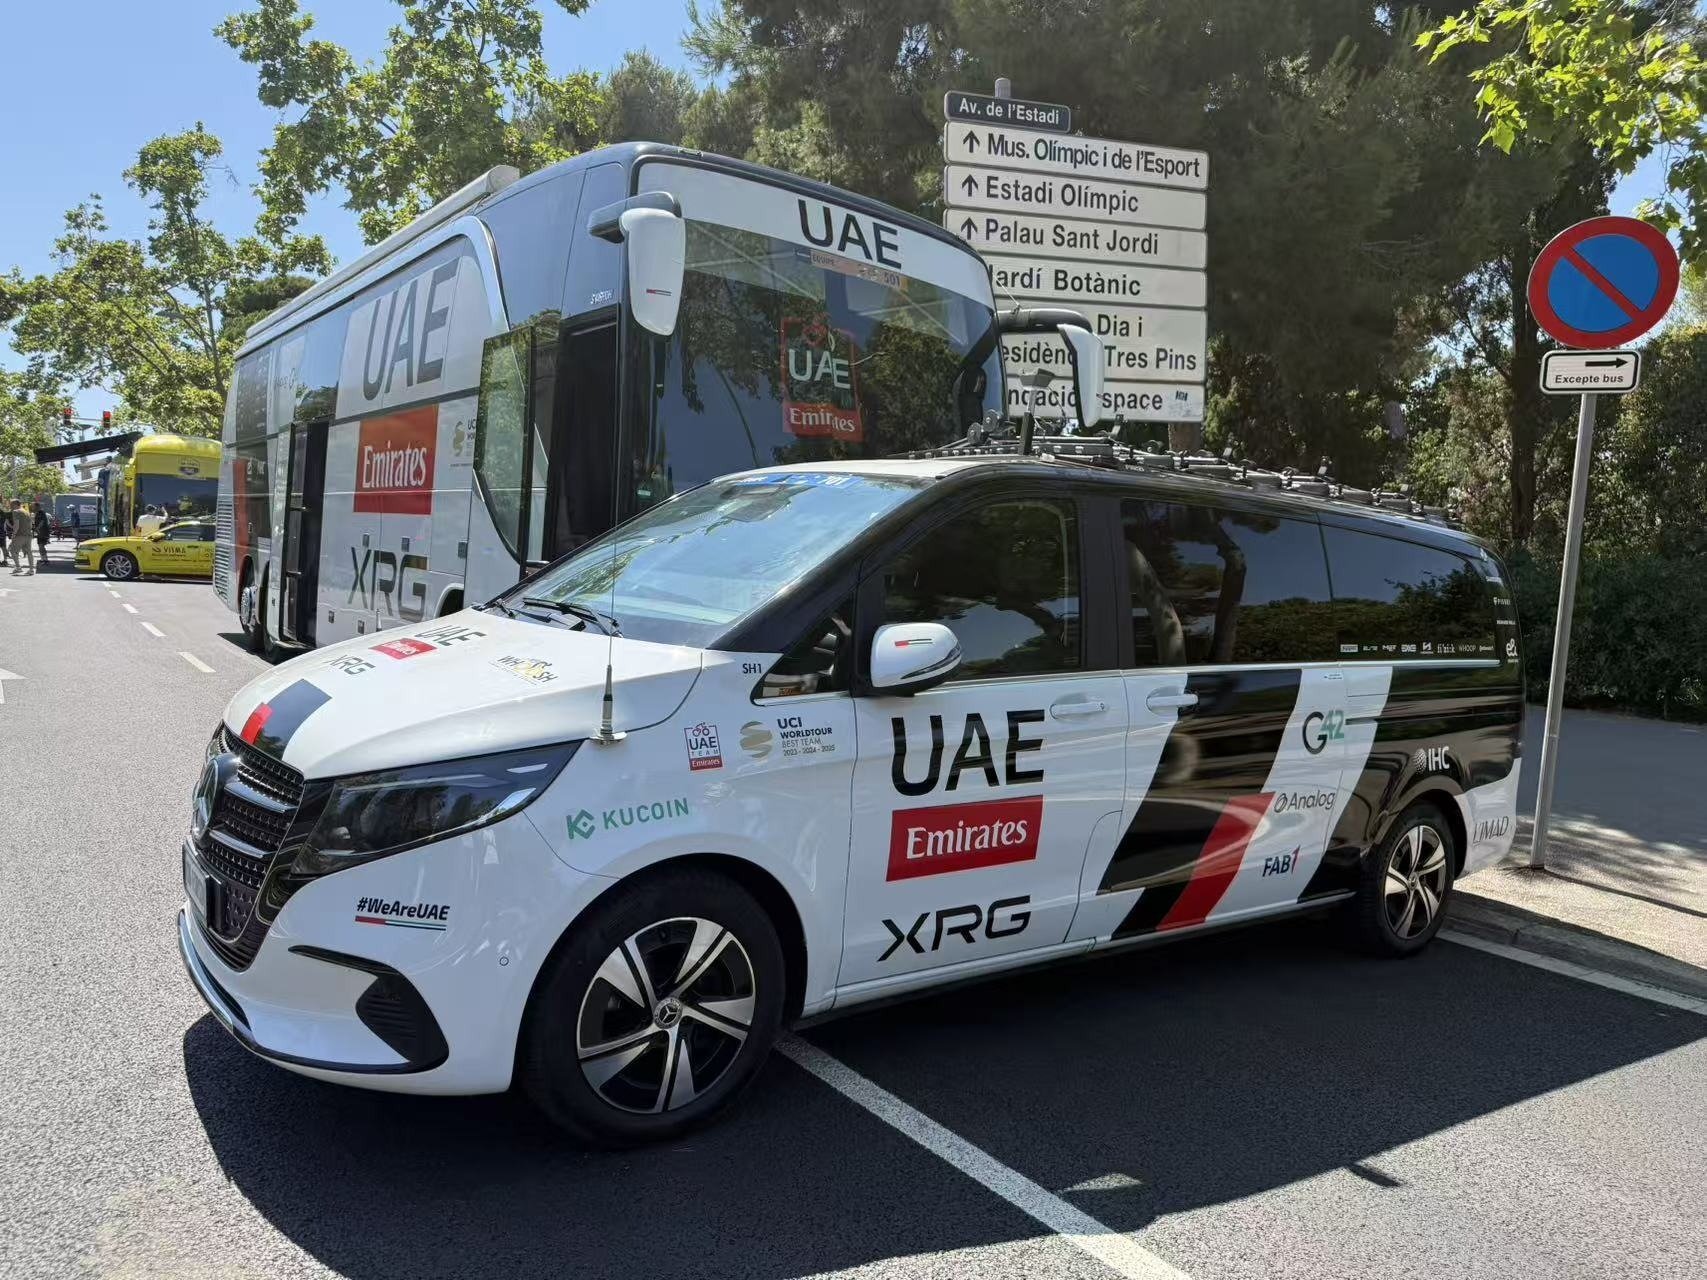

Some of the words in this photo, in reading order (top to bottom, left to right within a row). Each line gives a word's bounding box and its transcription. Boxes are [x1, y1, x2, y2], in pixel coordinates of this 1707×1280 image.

[959, 98, 981, 115] Av.
[986, 101, 1003, 117] de
[1008, 102, 1059, 125] l'Estadi
[987, 133, 1030, 159] Mus.
[1034, 138, 1099, 169] Olímpic
[1102, 147, 1108, 167] i
[1111, 148, 1132, 171] de
[1136, 150, 1200, 179] l'Esport
[986, 176, 1053, 204] Estadi
[1061, 184, 1139, 215] Olímpic
[798, 199, 902, 269] UAE
[985, 218, 1044, 245] Palau
[1053, 224, 1099, 250] Sant
[1106, 230, 1158, 255] Jordi
[1054, 268, 1141, 296] Botànic
[363, 256, 462, 400] UAE
[1097, 313, 1130, 337] Dia
[1137, 316, 1143, 337] i
[788, 349, 851, 389] UAE
[1104, 345, 1148, 368] Tres
[1155, 348, 1197, 370] Pins
[1555, 374, 1600, 385] Excepte
[1602, 374, 1624, 383] bus
[361, 436, 426, 489] Emirates
[350, 547, 428, 616] XRG
[742, 663, 762, 674] SH1
[777, 716, 803, 729] UCI
[780, 727, 833, 739] WORLDTOUR
[1302, 709, 1345, 755] G42
[689, 736, 718, 750] UAE
[782, 740, 800, 748] BEST
[801, 738, 822, 746] TEAM
[891, 709, 1045, 796] UAE
[1428, 746, 1450, 771] IHC
[602, 797, 689, 830] KUCOIN
[1288, 790, 1336, 810] Analog
[906, 819, 1028, 859] Emirates
[357, 897, 450, 920] #WeAreUAE
[876, 895, 1032, 962] XRG
